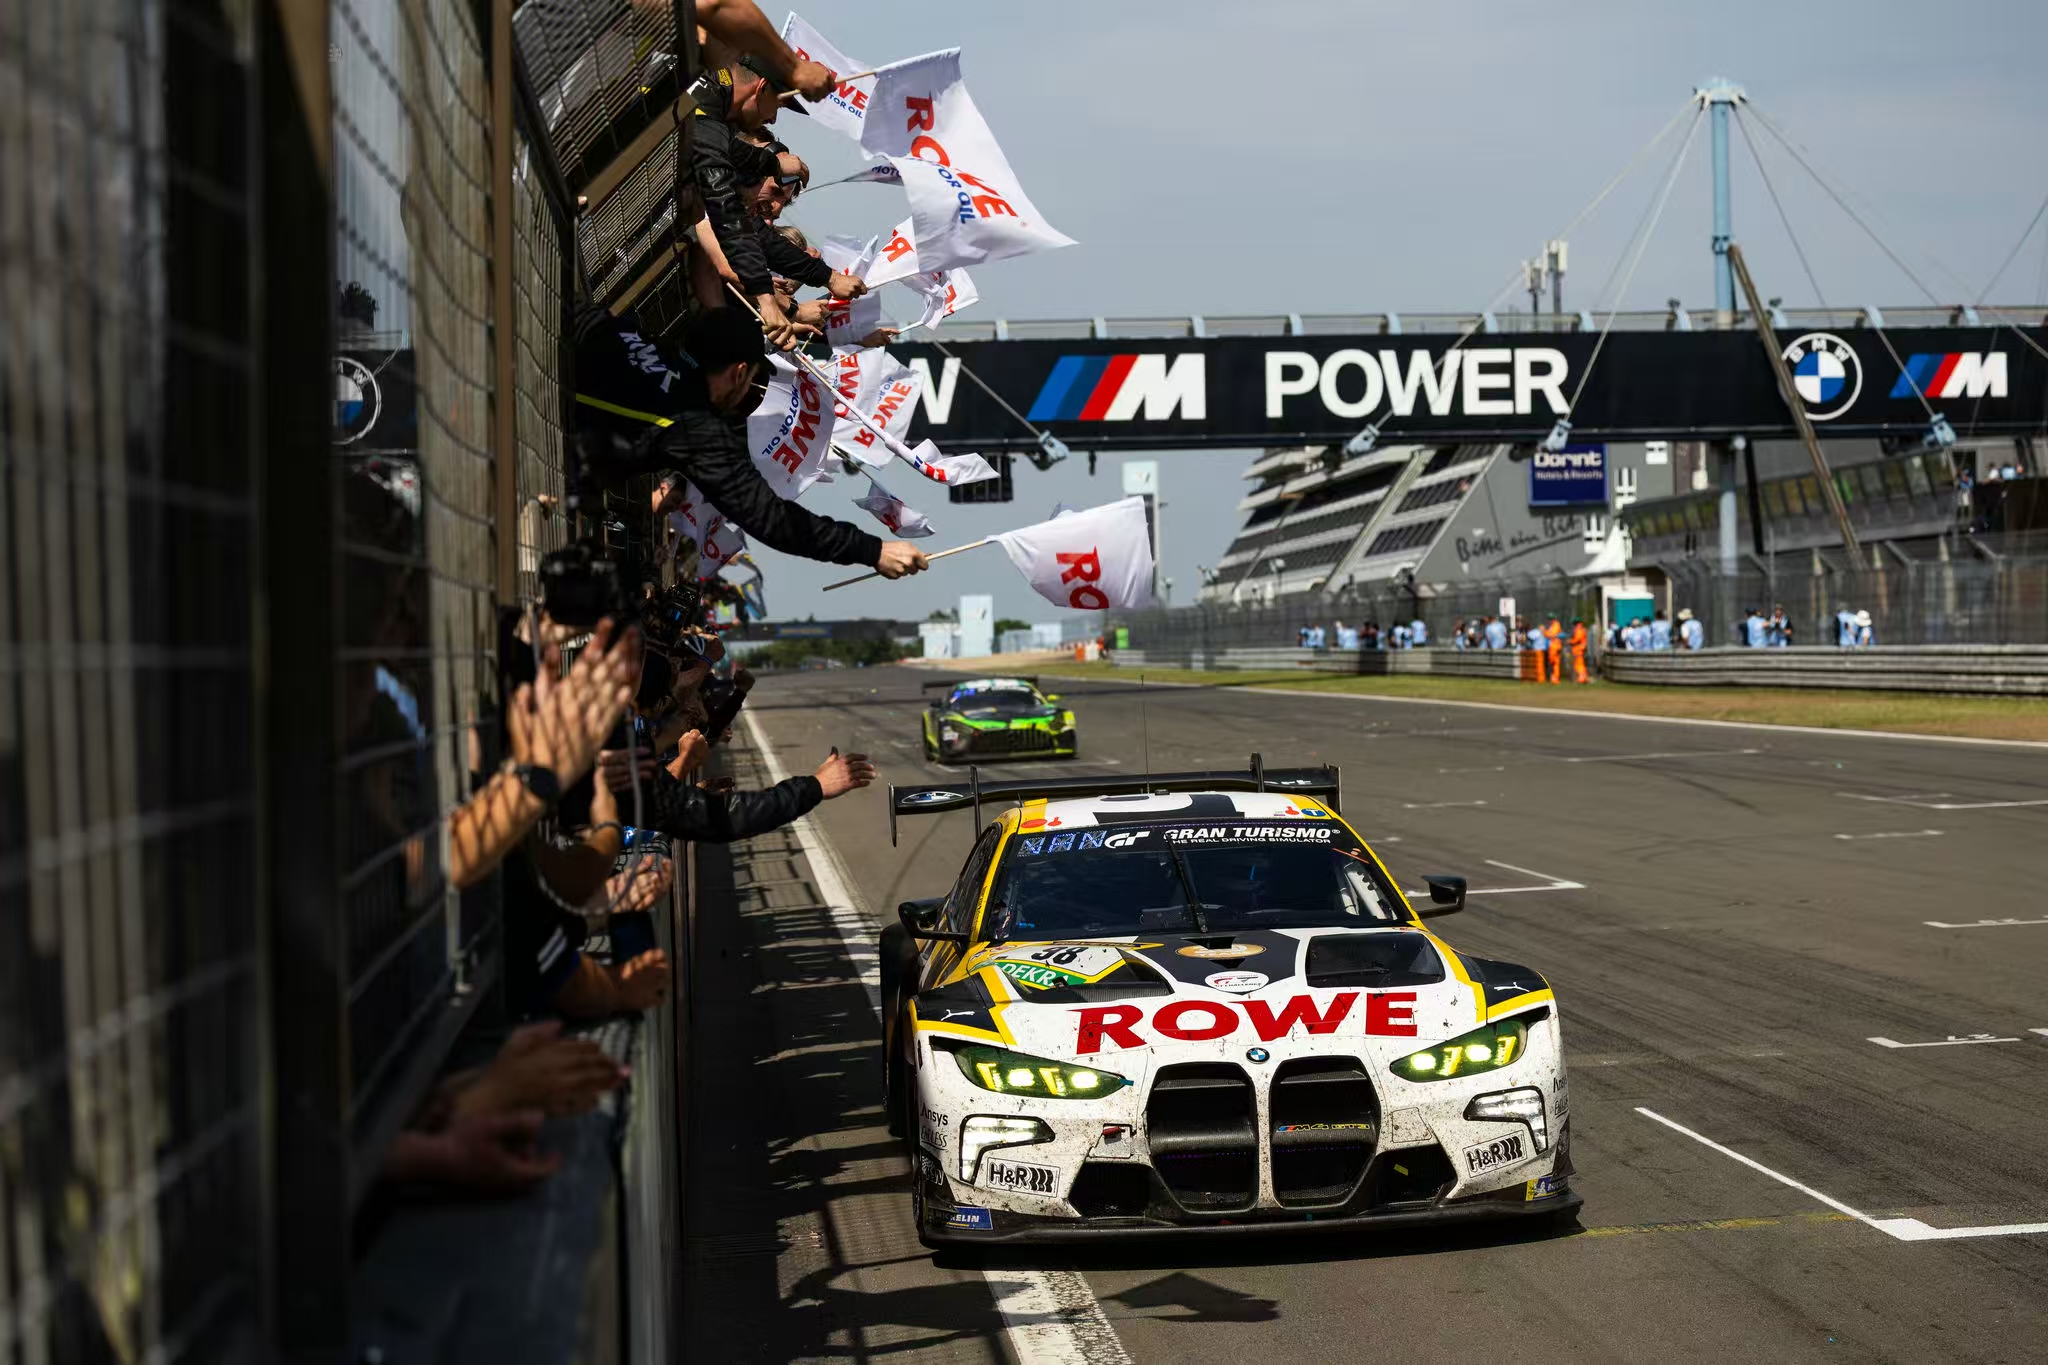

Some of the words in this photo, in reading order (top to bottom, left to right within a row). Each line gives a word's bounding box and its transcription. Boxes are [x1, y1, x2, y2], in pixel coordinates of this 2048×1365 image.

[848, 106, 863, 119] OIL
[958, 191, 976, 224] OIL
[1265, 347, 1570, 418] POWER
[762, 436, 781, 455] OIL
[1056, 545, 1110, 610] RO
[1163, 827, 1230, 840] GRAN
[1066, 992, 1418, 1055] ROWE
[920, 1102, 949, 1127] Ansys
[1466, 1141, 1502, 1171] H&R
[990, 1161, 1030, 1187] H&R
